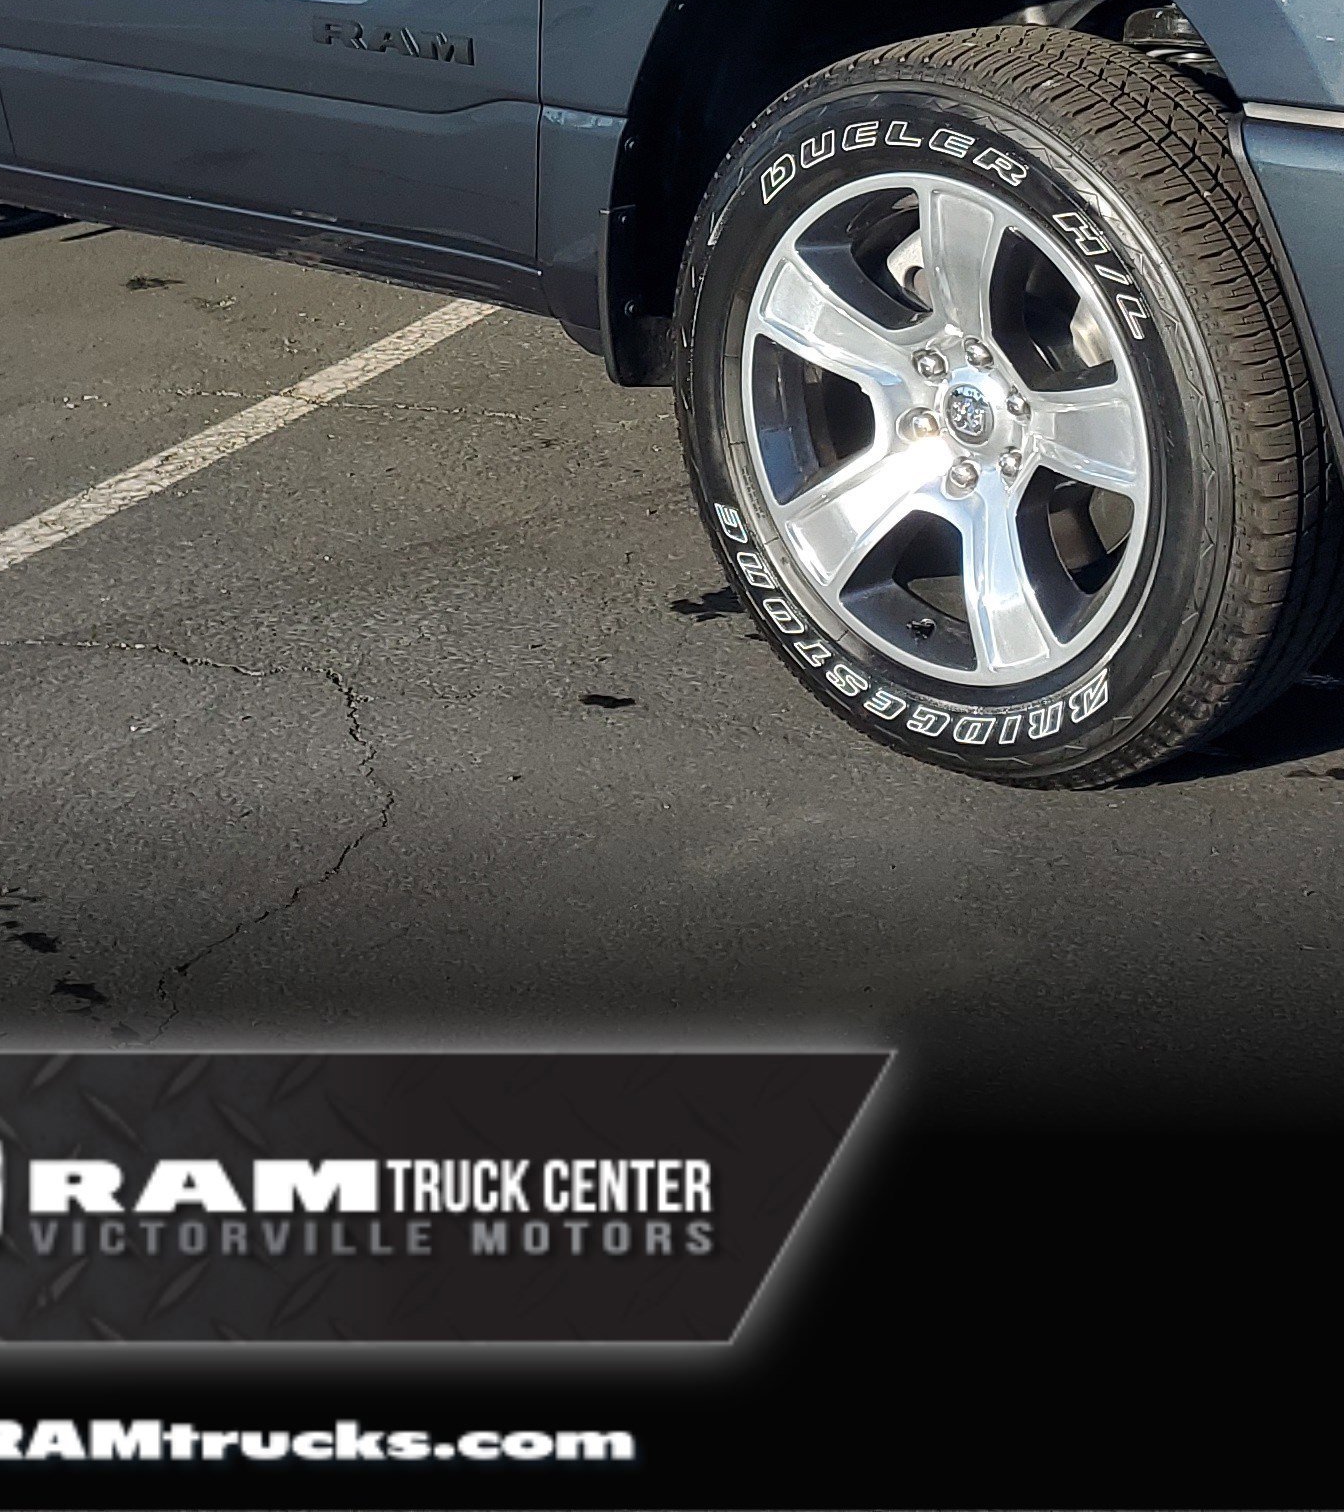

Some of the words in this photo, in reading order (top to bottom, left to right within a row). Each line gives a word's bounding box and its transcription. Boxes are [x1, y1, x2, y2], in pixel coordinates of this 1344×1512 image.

[313, 16, 476, 67] RAM
[760, 120, 1028, 205] DUELER
[1052, 211, 1154, 341] H/L
[713, 501, 1110, 746] BRIDGESTONE
